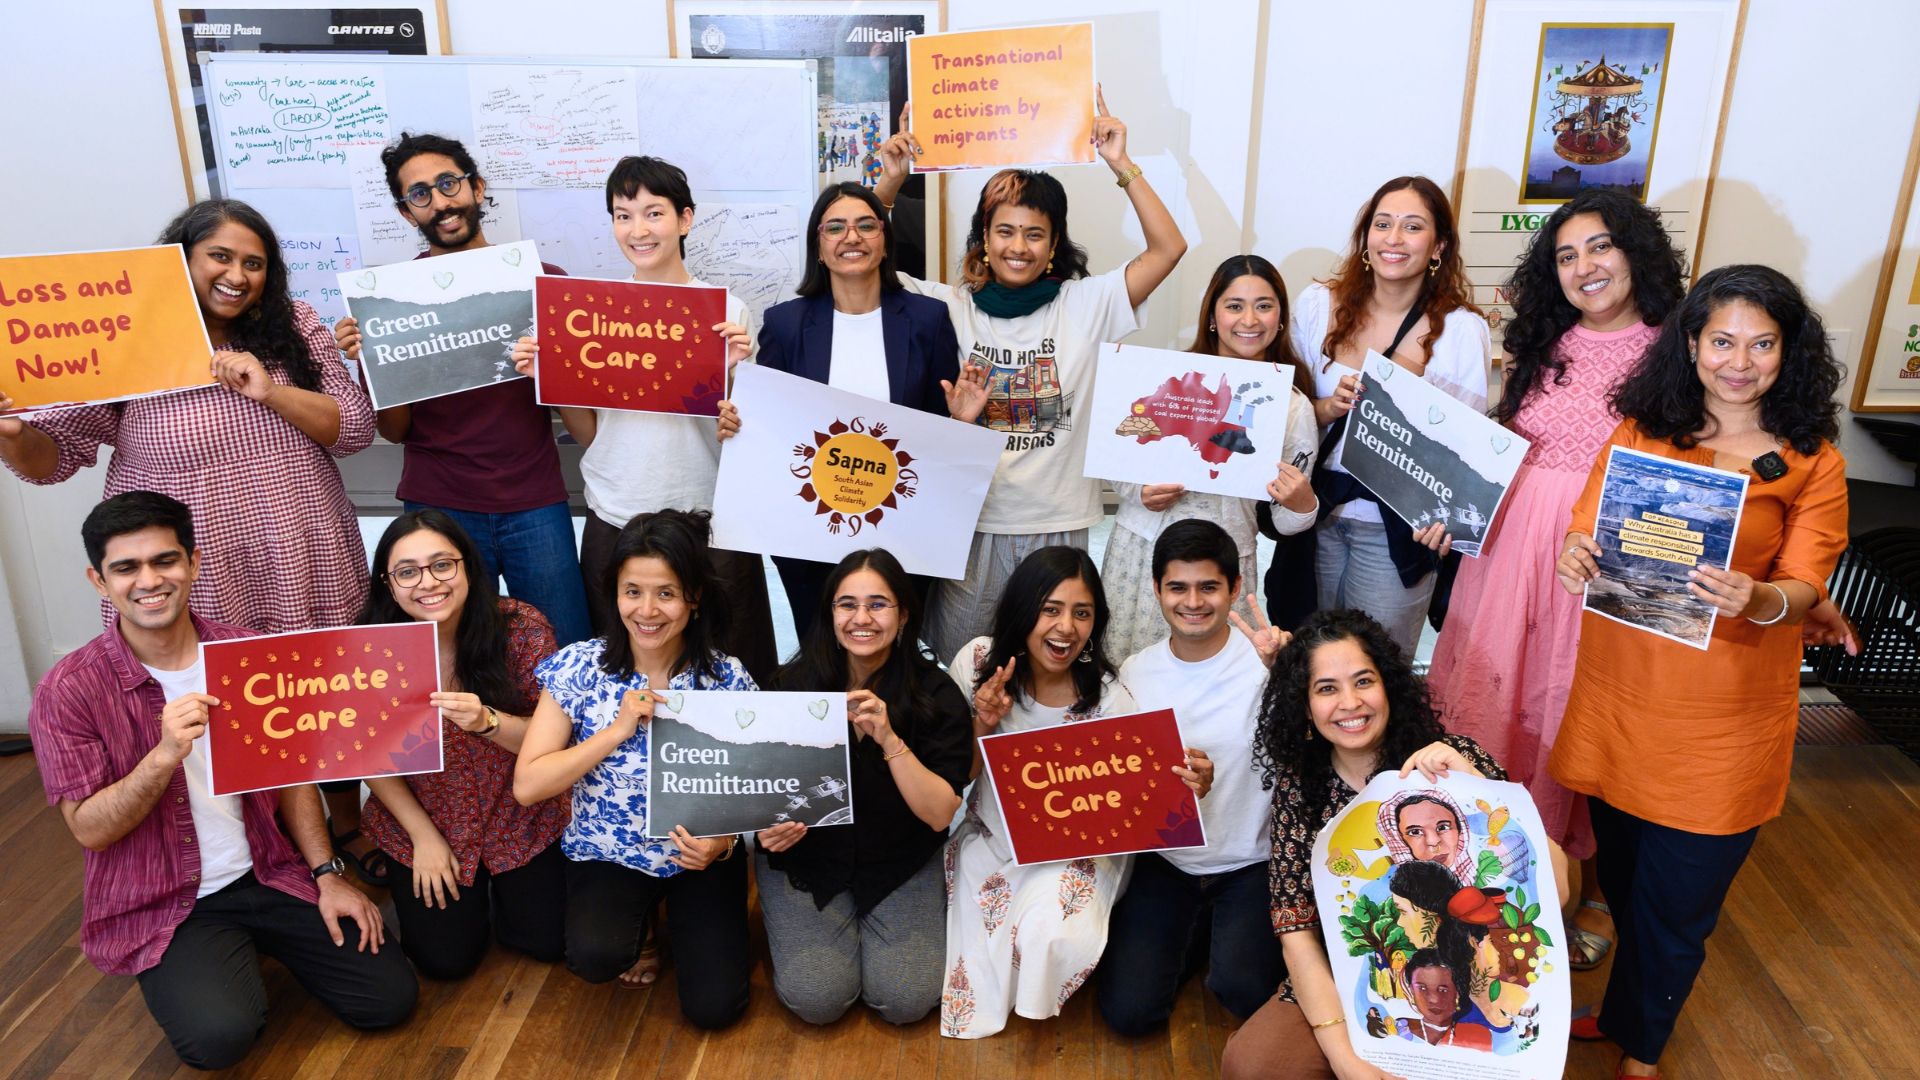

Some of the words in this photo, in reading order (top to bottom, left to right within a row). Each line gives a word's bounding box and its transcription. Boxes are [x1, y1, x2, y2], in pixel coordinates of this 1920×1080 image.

[193, 23, 232, 36] NANDA
[233, 23, 262, 36] Pasta
[327, 25, 395, 35] QANTAS
[931, 44, 1063, 70] Transnational
[932, 77, 1000, 96] climate
[282, 112, 326, 126] LABOUR
[932, 102, 1011, 119] activism
[1017, 97, 1041, 120] by
[934, 126, 1018, 149] migrants
[280, 240, 322, 251] SSION
[334, 236, 349, 253] 1
[317, 259, 338, 271] art
[0, 281, 67, 307] Loss
[78, 270, 133, 296] and
[6, 314, 131, 345] Damage
[364, 309, 441, 339] Green
[565, 308, 686, 342] Climate
[376, 321, 513, 366] Remittance
[1017, 338, 1055, 365] HOES
[16, 347, 101, 383] Now!
[579, 341, 657, 371] Care
[1164, 392, 1195, 402] Australia
[1169, 412, 1194, 420] exports
[1195, 414, 1218, 425] globally
[1191, 406, 1221, 415] proposed
[1360, 399, 1413, 447] Green
[826, 447, 887, 476] Sapna
[1354, 420, 1453, 503] Remittance
[833, 474, 854, 484] South
[855, 477, 874, 487] Asian
[839, 485, 864, 496] Climate
[833, 494, 867, 508] Solidarity
[1627, 520, 1645, 530] Why
[1646, 524, 1678, 535] Australia
[1679, 530, 1691, 539] has
[1658, 516, 1685, 527] REASONS
[1622, 532, 1650, 543] climate
[1650, 538, 1699, 554] responsibility
[1624, 545, 1654, 556] towards
[1655, 550, 1677, 560] South
[1677, 555, 1693, 564] Asia
[243, 666, 389, 706] Climate
[262, 706, 357, 739] Care
[660, 742, 730, 766] Green
[661, 771, 801, 795] Remittance
[1021, 753, 1142, 790] Climate
[1043, 790, 1122, 819] Care
